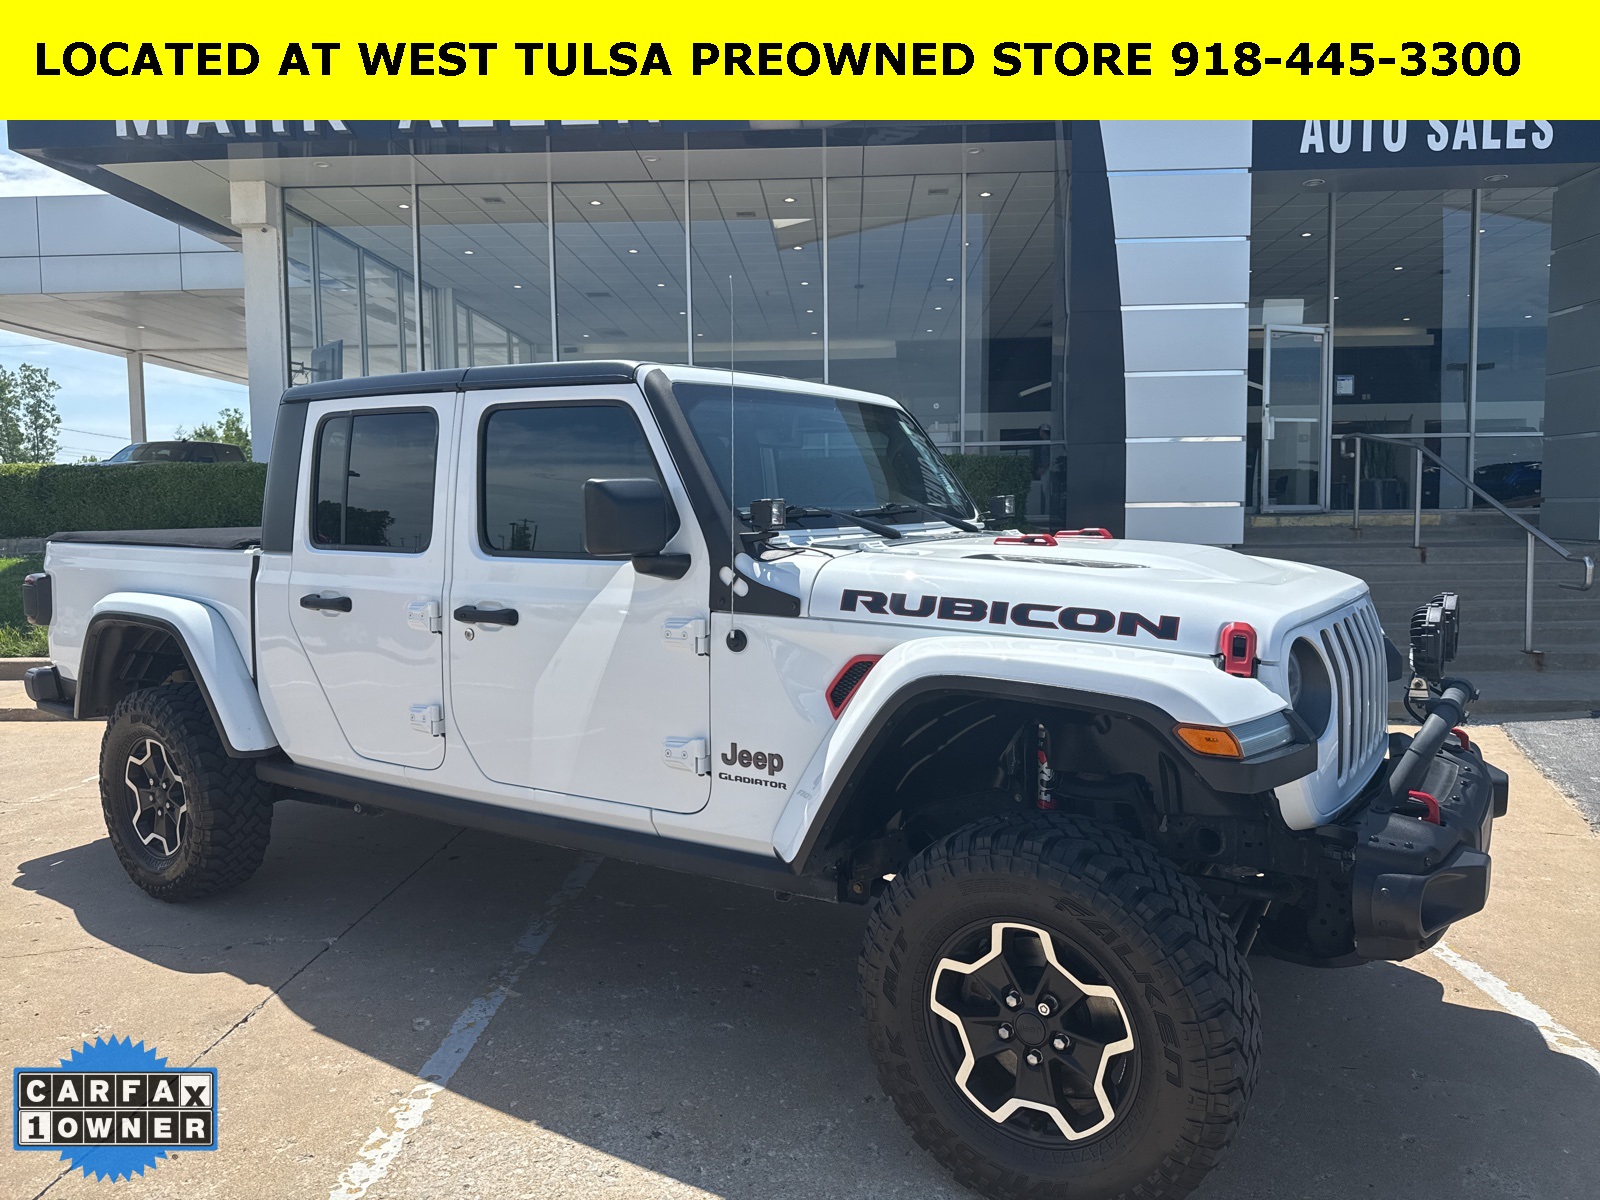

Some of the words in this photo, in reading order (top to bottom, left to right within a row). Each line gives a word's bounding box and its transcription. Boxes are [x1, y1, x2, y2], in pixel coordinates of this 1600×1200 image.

[1426, 120, 1555, 151] SALES
[839, 588, 1181, 641] RUBICON
[720, 742, 784, 776] Jeep
[718, 771, 787, 791] GLADIATOR
[1048, 895, 1184, 1089] FALKEN
